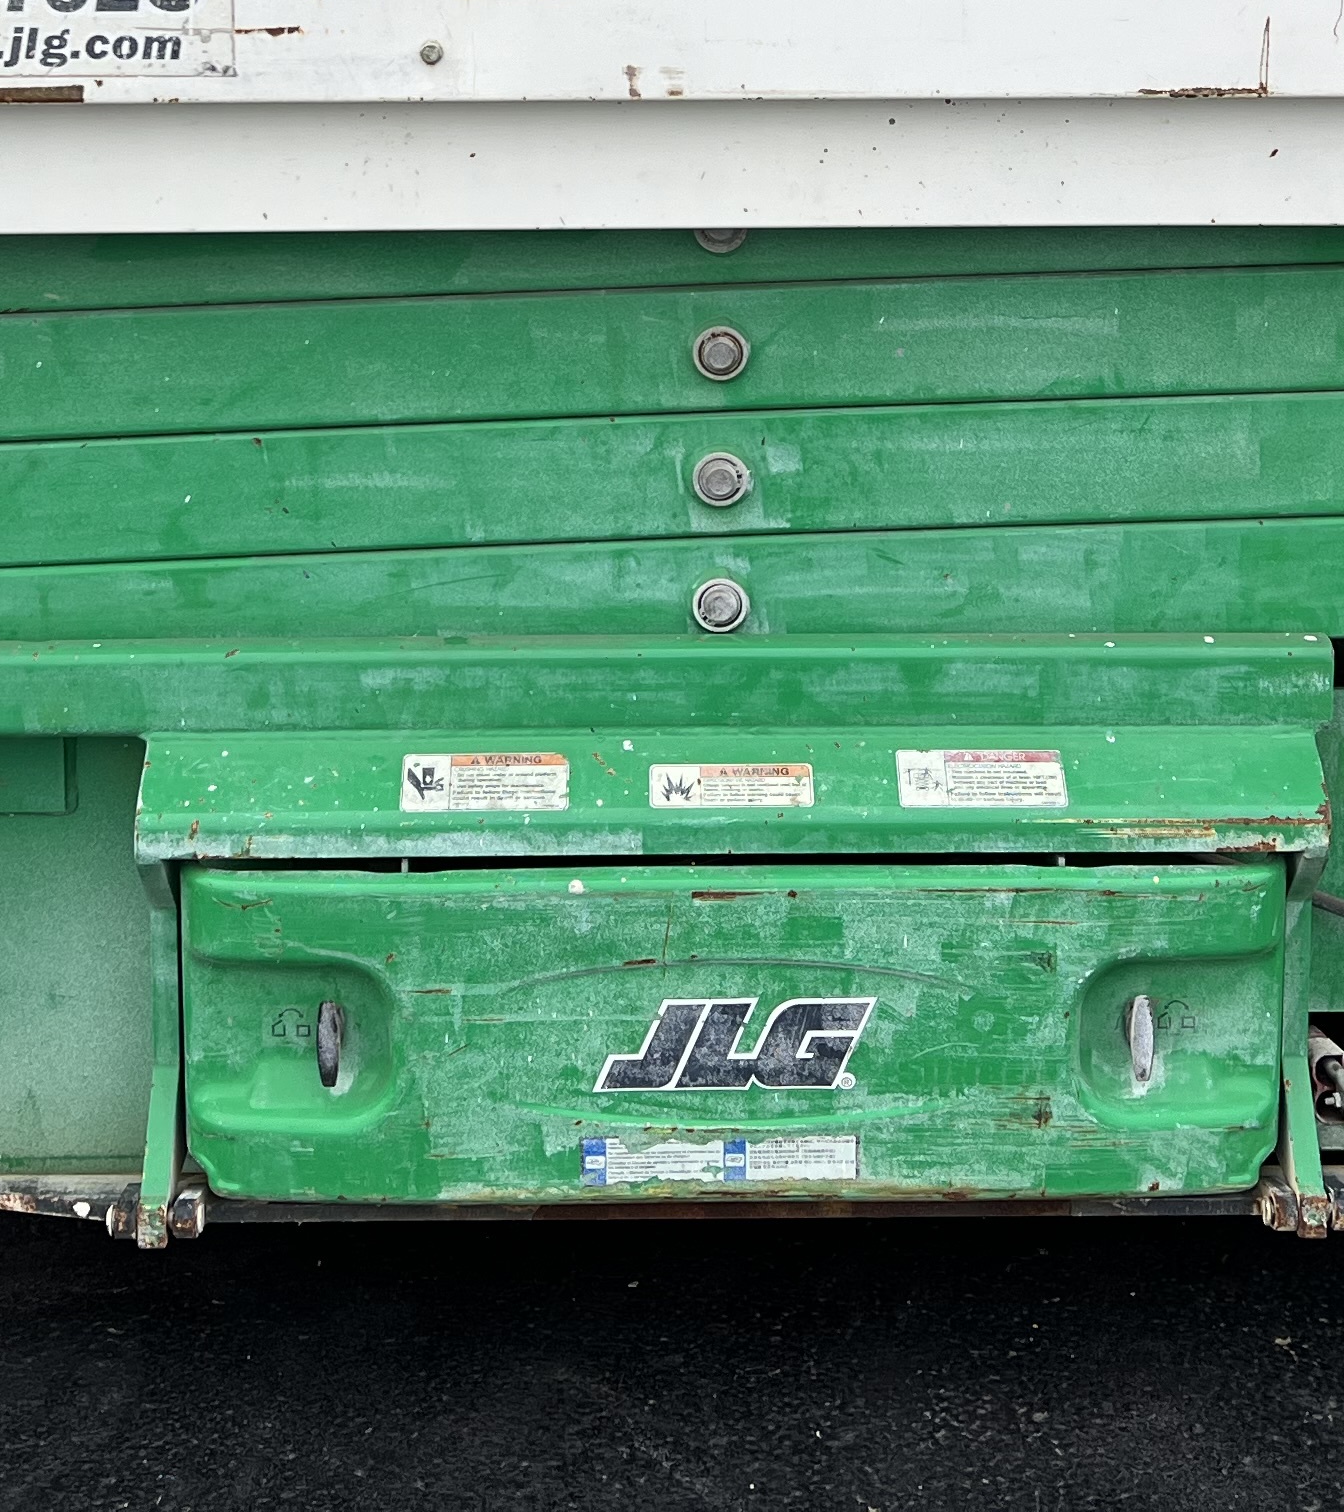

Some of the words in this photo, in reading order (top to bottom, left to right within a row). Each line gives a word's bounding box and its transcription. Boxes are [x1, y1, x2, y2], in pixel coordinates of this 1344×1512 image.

[484, 755, 542, 765] WARNING
[980, 751, 1026, 761] DANGER
[732, 767, 790, 776] WARNING
[592, 997, 878, 1093] JLG
